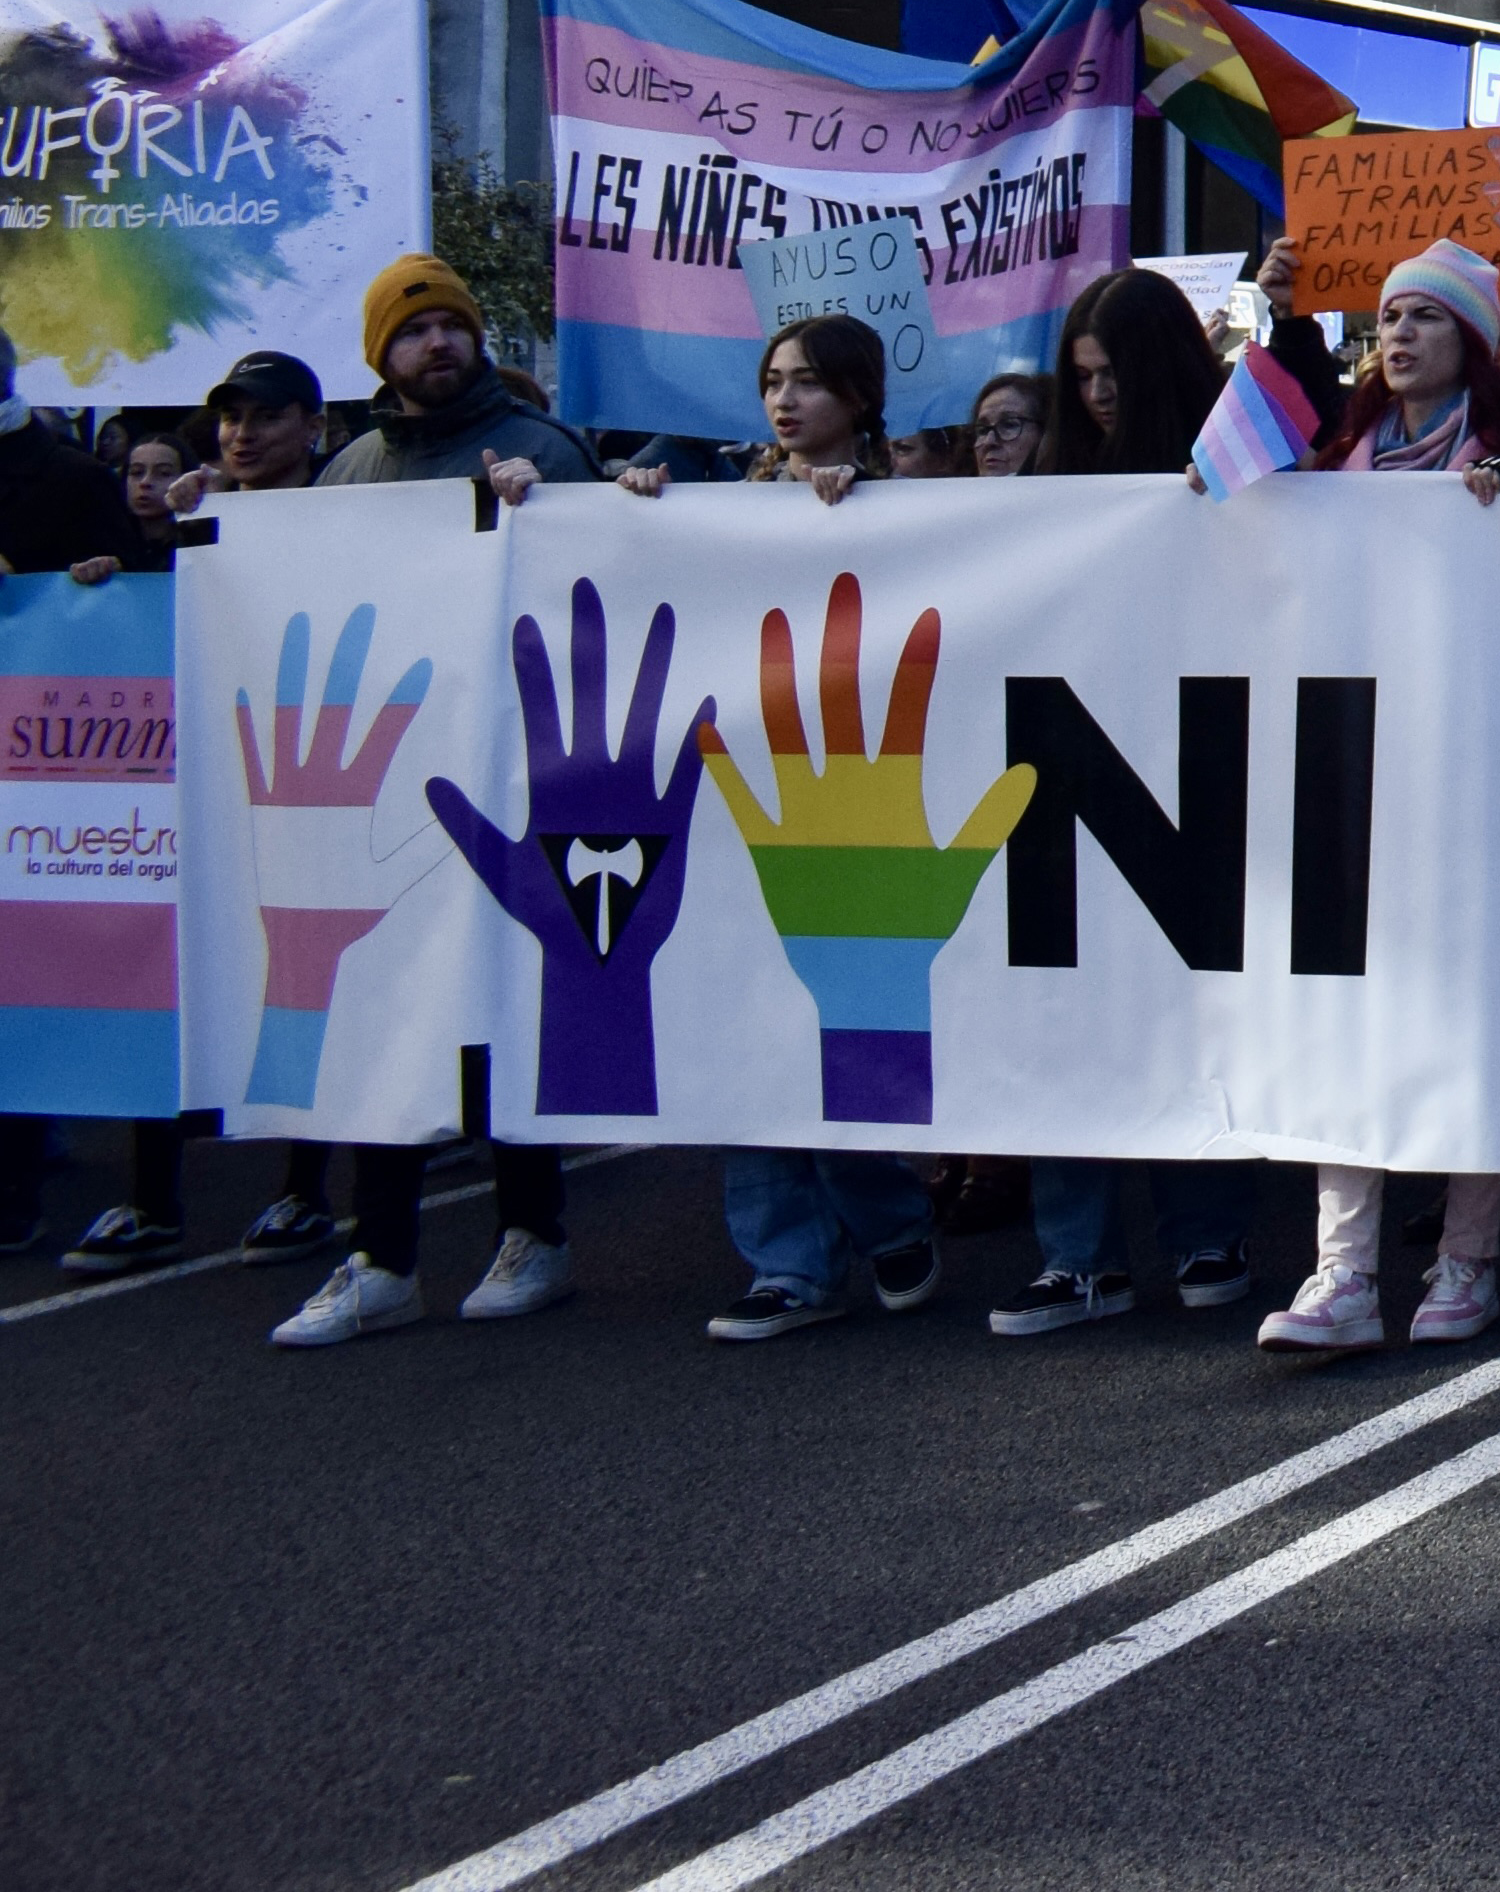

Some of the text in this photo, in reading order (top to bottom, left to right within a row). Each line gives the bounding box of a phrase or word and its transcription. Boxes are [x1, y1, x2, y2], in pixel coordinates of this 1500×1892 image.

[0, 83, 275, 193] UFORIA
[861, 124, 888, 154] O
[909, 121, 960, 155] NO
[63, 192, 280, 229] Trans-Aliadas
[559, 151, 642, 254] LES
[1337, 181, 1480, 216] TRANS
[771, 232, 897, 288] AYUSO
[866, 290, 911, 316] UN
[8, 806, 177, 856] muestr
[1008, 674, 1379, 976] NI
[27, 858, 42, 875] la
[47, 860, 103, 876] cultura
[108, 860, 134, 876] del
